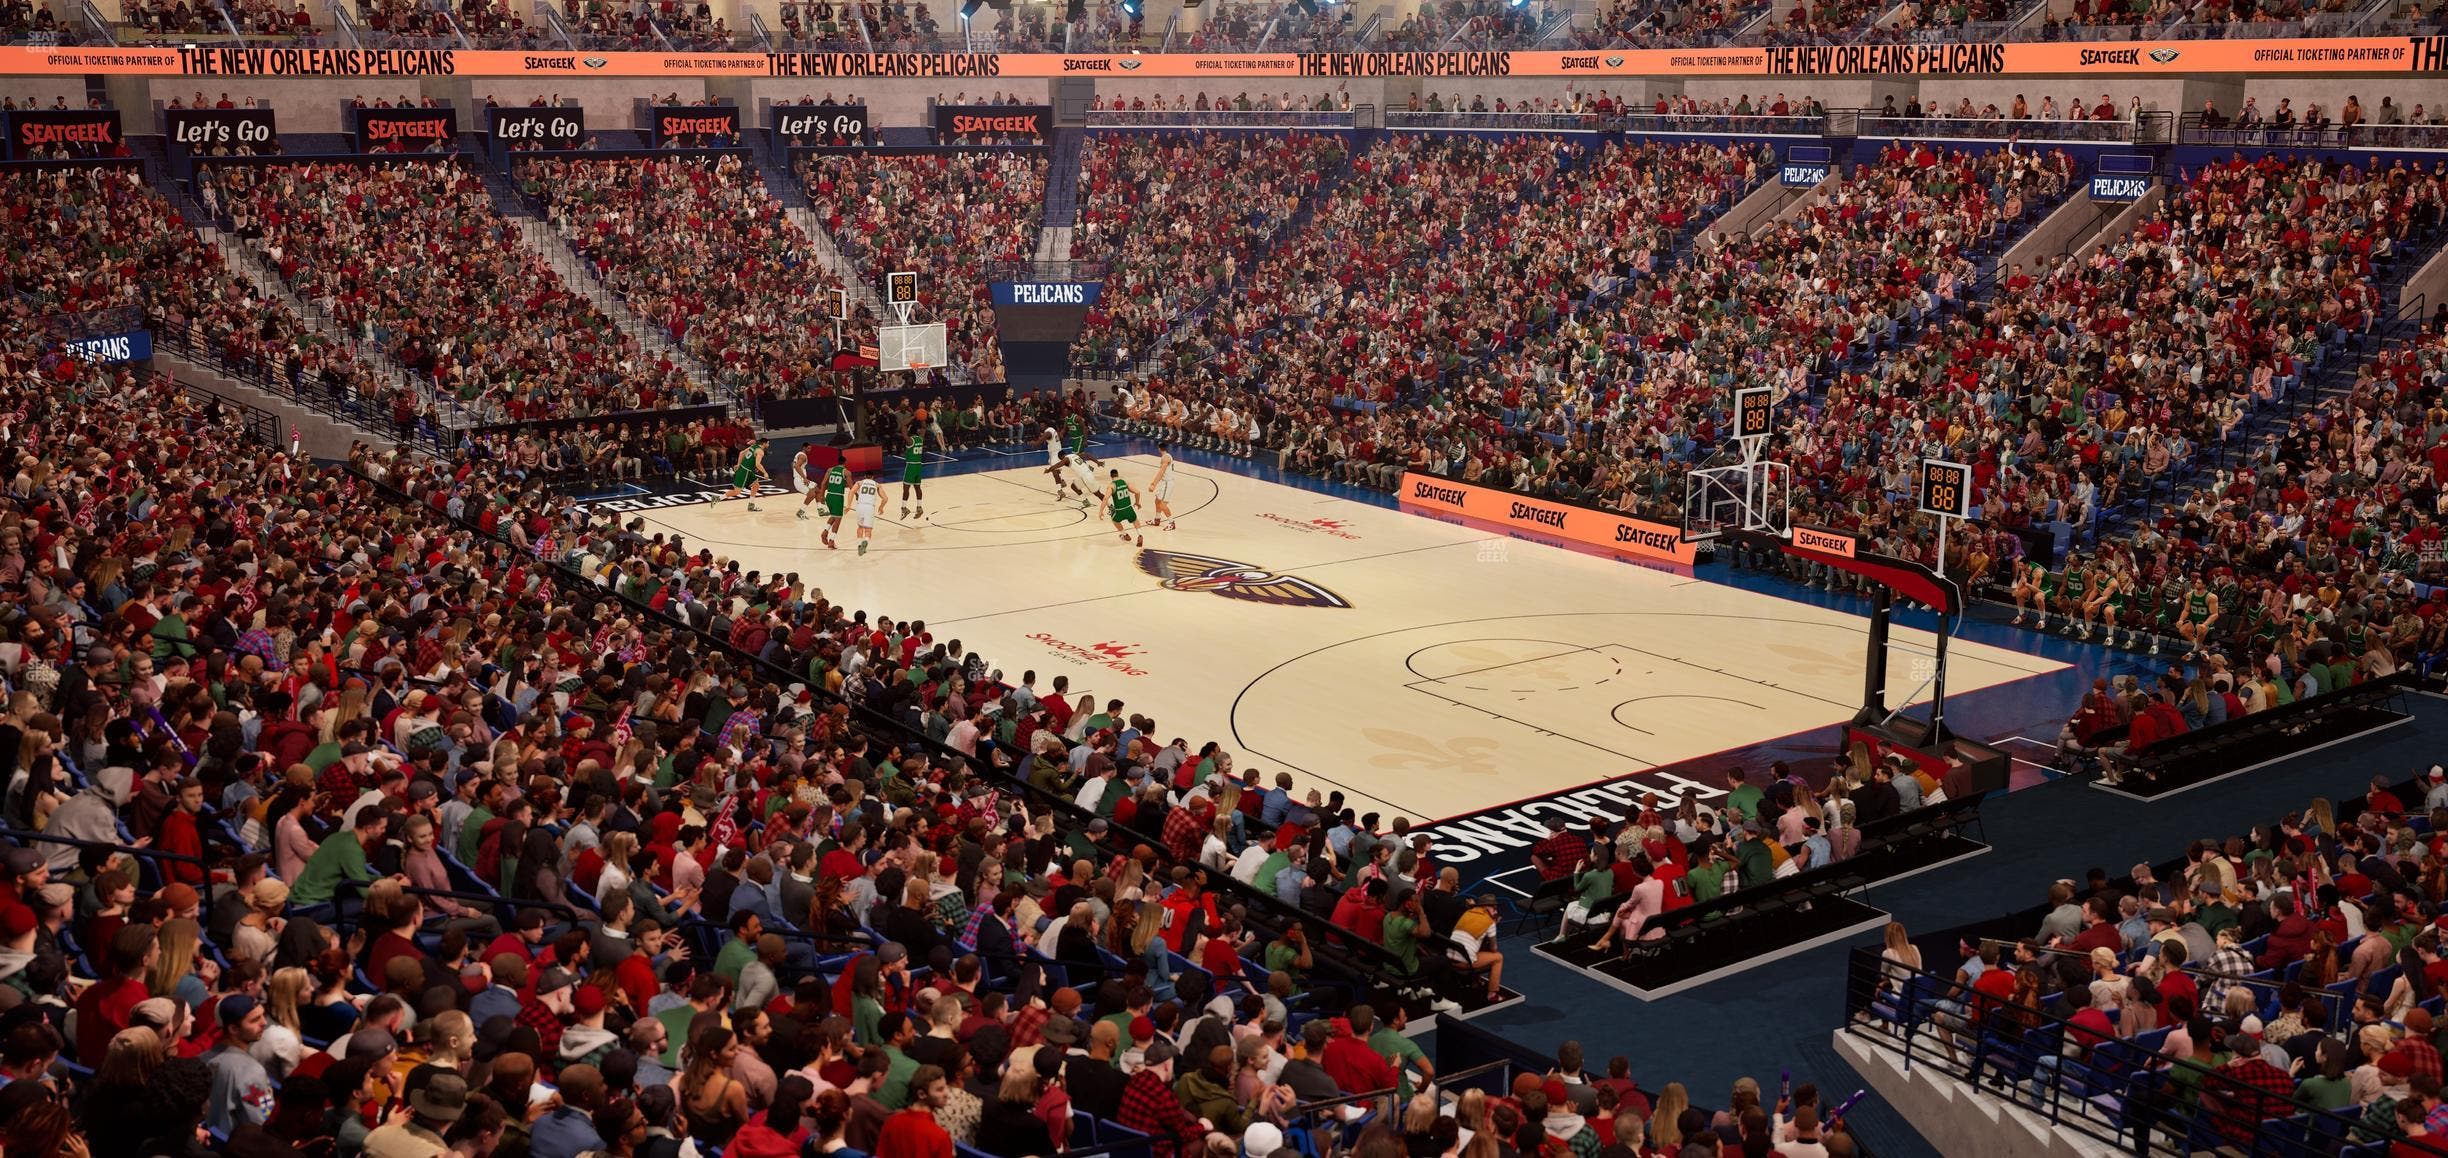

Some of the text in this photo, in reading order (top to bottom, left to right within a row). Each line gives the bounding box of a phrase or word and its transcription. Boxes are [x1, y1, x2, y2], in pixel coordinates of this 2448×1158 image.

[48, 48, 454, 75] OFFICIAL TICKETING PARTNER OF THE NEW ORLEANS PELICANS
[525, 56, 576, 70] SEATGEEK
[664, 53, 999, 76] OFFICIAL TICKETING PARTNER OF THE NEW ORLEANS PELICANS
[1064, 58, 1111, 71] SEATGEEK
[1195, 52, 1510, 76] OFFICIAL TICKETING PARTNER OF THE NEW ORLEANS PELICANS
[1561, 55, 1600, 69] SEATGEEK
[1671, 45, 2005, 74] OFFICIAL TICKETING PARTNER OF THE NEW ORLEANS PELICANS
[2080, 48, 2140, 66] SEATGEEK
[2254, 48, 2294, 62] OFFICIAL
[2296, 47, 2344, 61] TICKETING
[2347, 47, 2390, 61] PARTNER
[2392, 47, 2405, 60] OF
[21, 120, 112, 145] SEATGEEK
[176, 120, 270, 142] Let's Go
[368, 119, 448, 140] SEATGEEK
[498, 117, 579, 138] Let's Go
[663, 116, 732, 135] SEATGEEK
[780, 115, 862, 135] Let's Go
[953, 115, 1039, 134] SEATGEEK
[2094, 178, 2146, 197] PELICANS
[896, 285, 911, 300] 88
[1013, 284, 1084, 303] PELICANS
[1746, 409, 1765, 431] 88
[1930, 466, 1960, 485] 88 88
[861, 486, 876, 496] 00
[1414, 481, 1467, 508] SEATGEEK
[1931, 484, 1955, 511] 88
[1510, 501, 1567, 530] SEATGEEK
[1615, 523, 1680, 554] SEATGEEK
[1799, 532, 1848, 553] SEATGEEK
